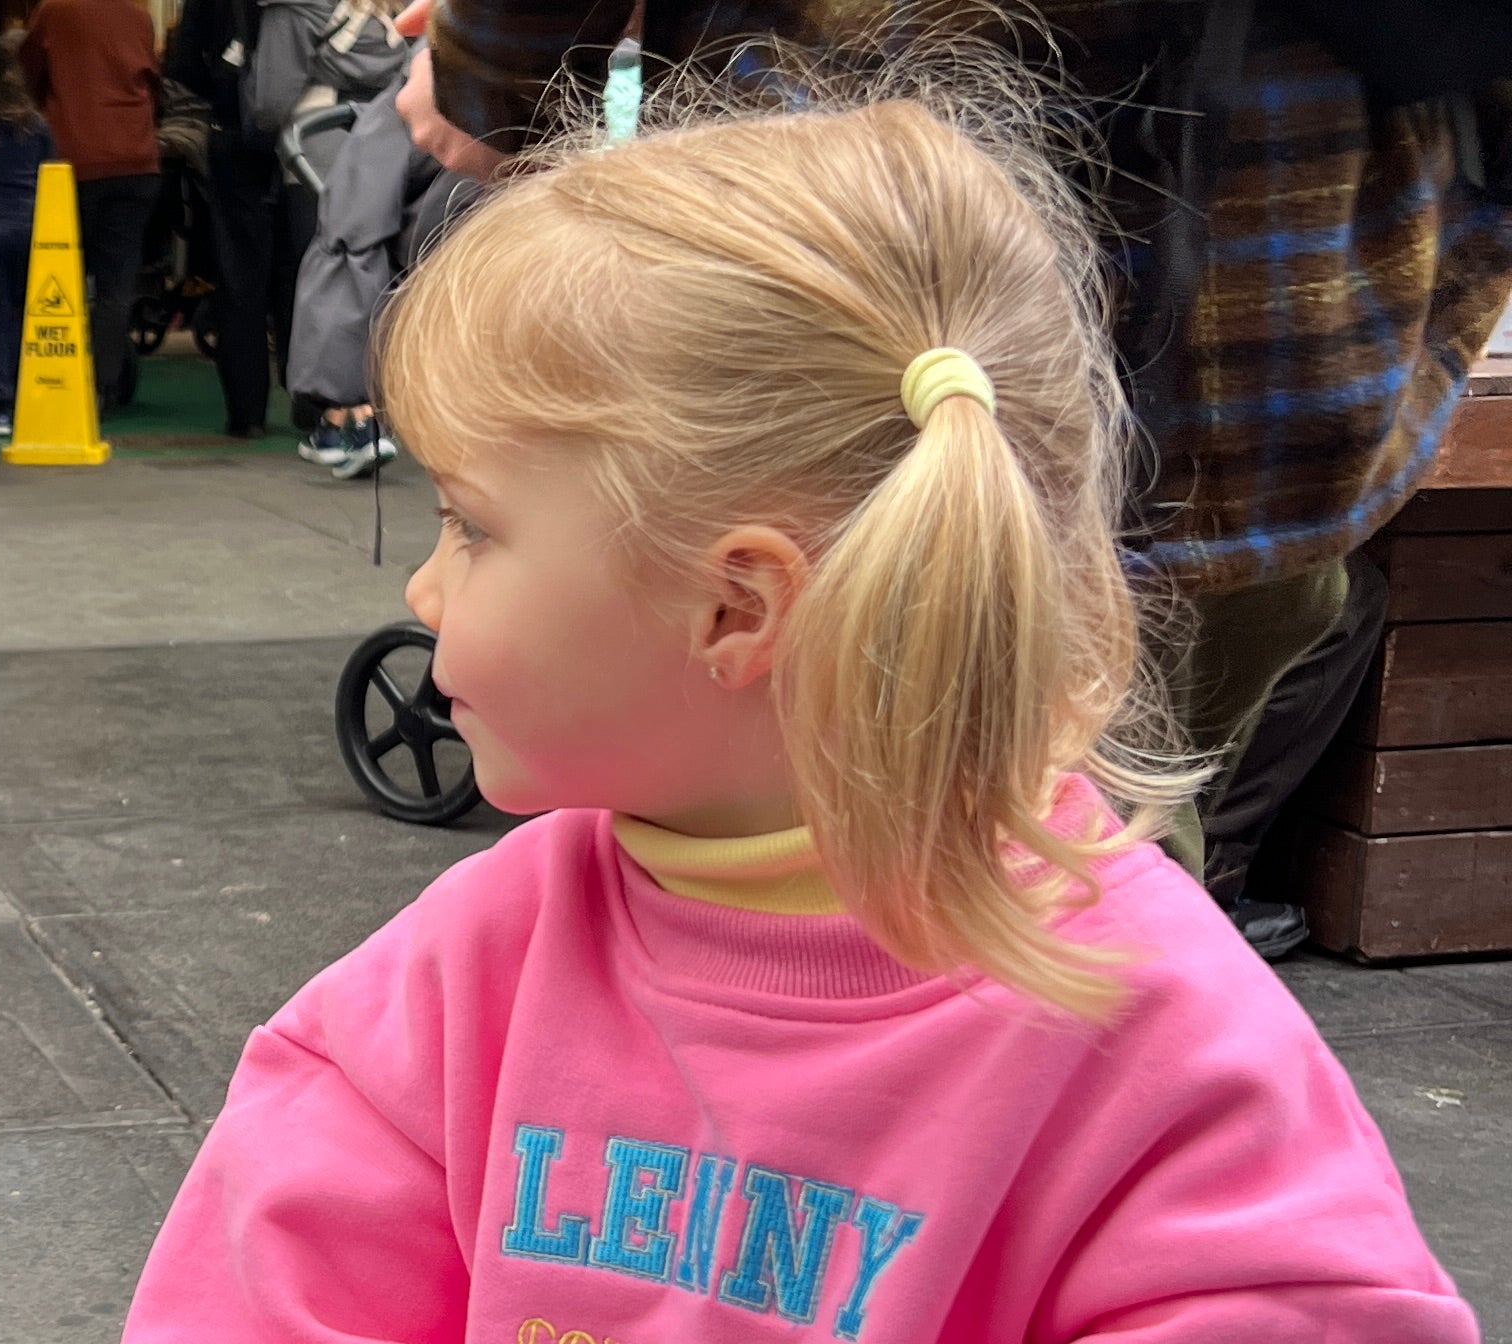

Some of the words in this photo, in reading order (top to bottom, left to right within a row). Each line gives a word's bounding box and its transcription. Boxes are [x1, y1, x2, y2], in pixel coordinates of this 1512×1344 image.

[35, 326, 70, 340] WET
[26, 341, 76, 357] FLOOR
[500, 1122, 927, 1344] LENNY
